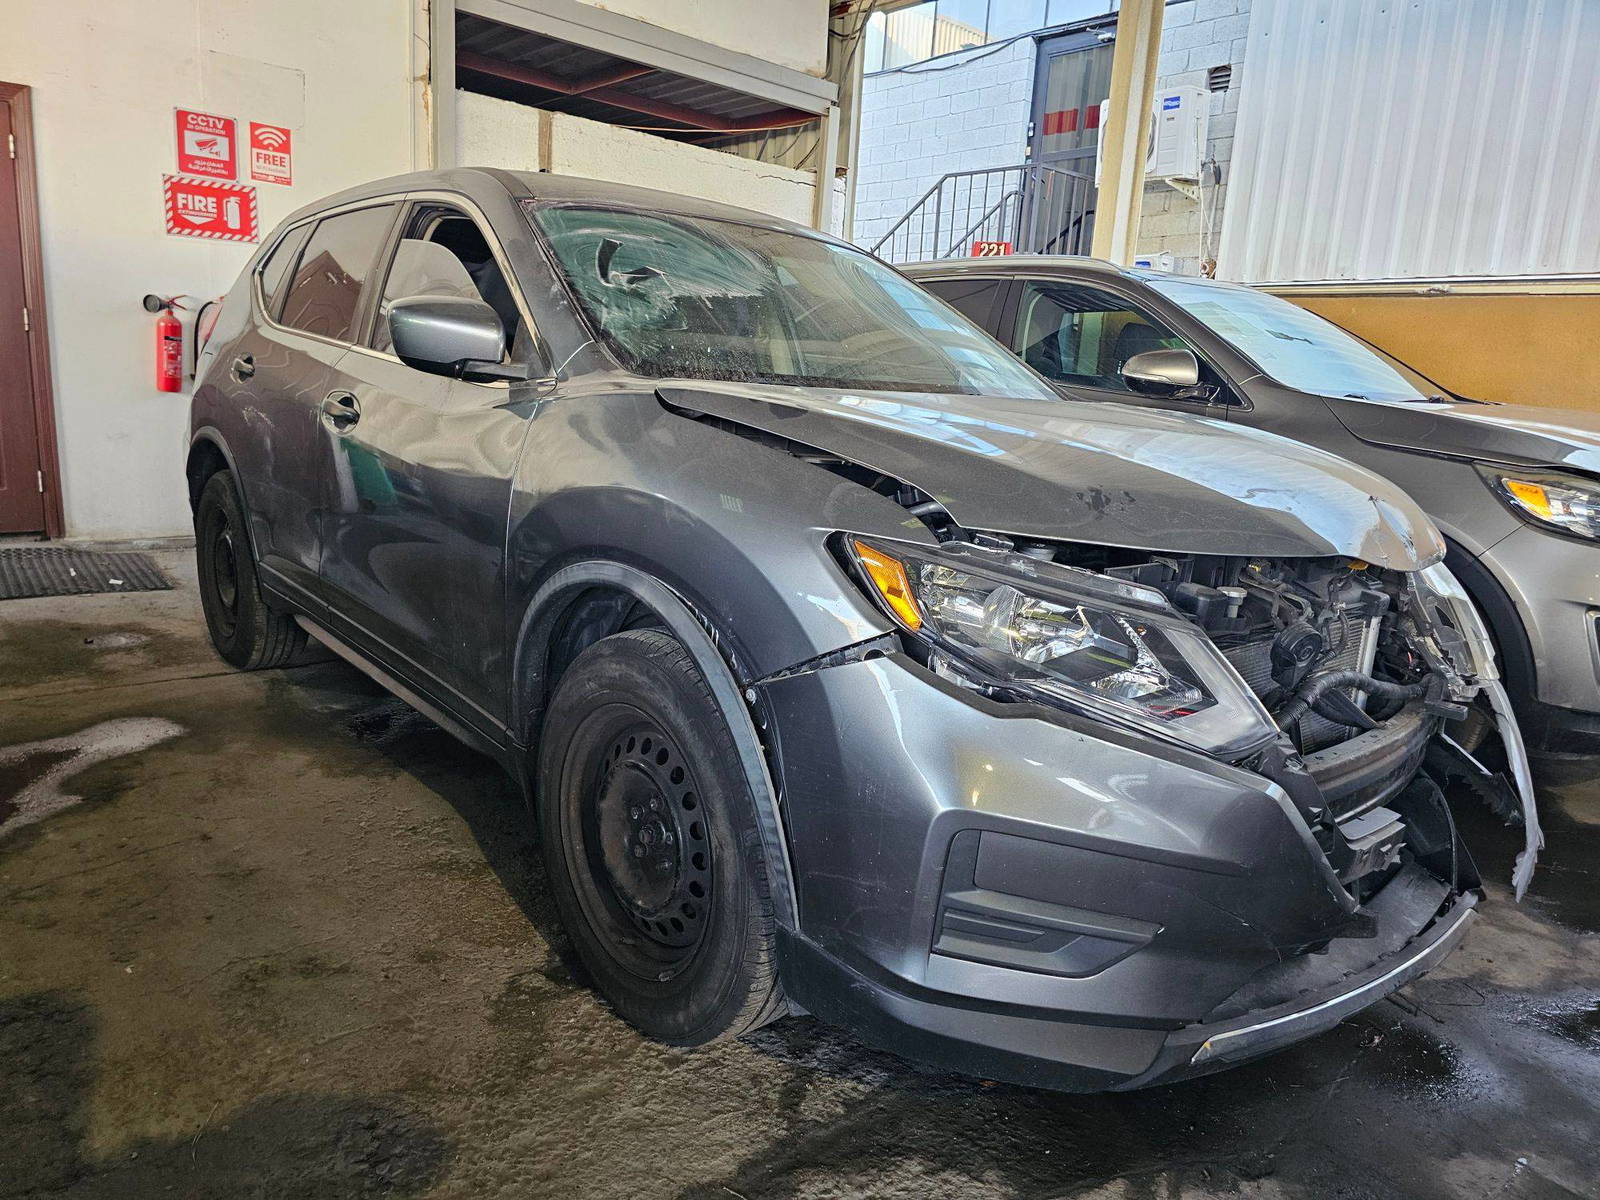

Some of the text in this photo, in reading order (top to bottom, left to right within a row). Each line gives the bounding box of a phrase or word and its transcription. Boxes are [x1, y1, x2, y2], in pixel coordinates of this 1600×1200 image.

[187, 114, 224, 128] CCTV
[256, 152, 287, 168] FREE
[177, 193, 217, 213] FIRE
[980, 243, 1005, 256] 221
